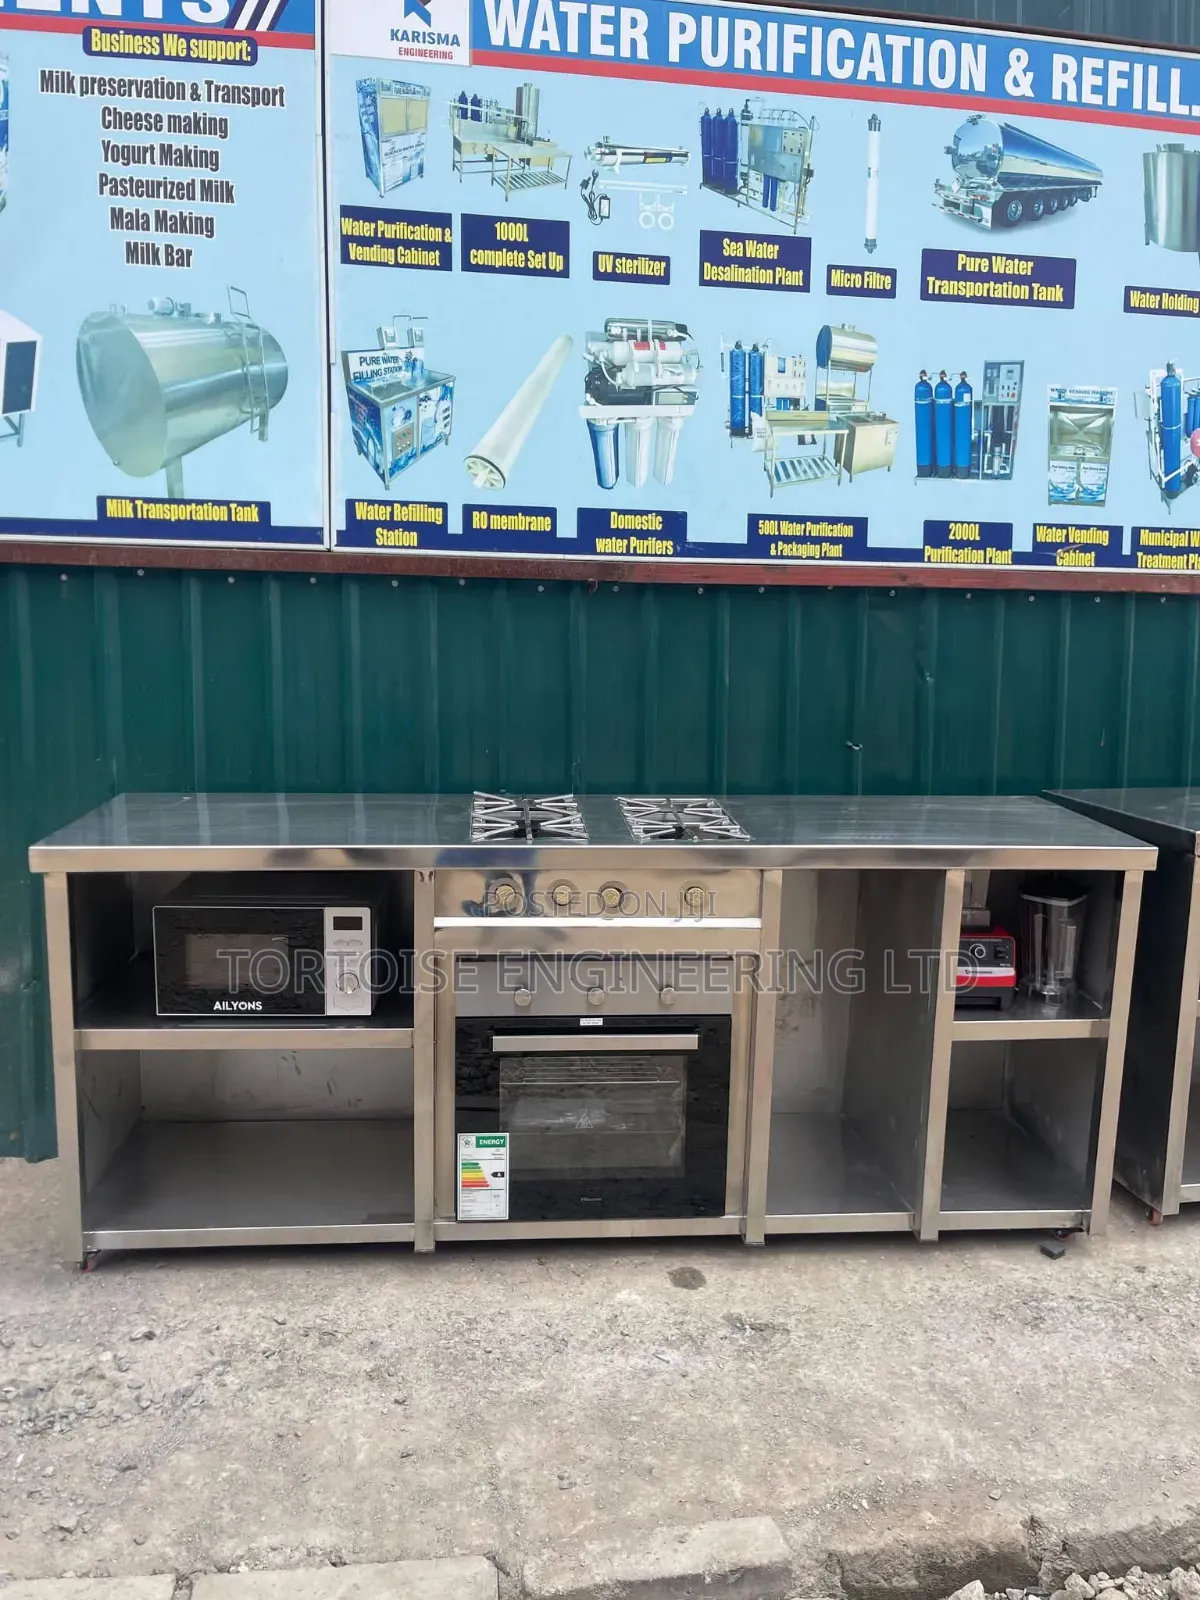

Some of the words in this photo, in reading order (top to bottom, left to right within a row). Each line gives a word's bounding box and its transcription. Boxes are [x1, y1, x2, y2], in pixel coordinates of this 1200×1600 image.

[91, 28, 160, 56] Business
[163, 33, 187, 57] We
[189, 38, 251, 62] support:
[390, 28, 461, 47] KARISMA
[398, 47, 453, 60] ENGINEERING
[484, 0, 649, 60] WATER
[669, 12, 986, 92] PURIFICATION
[1004, 47, 1035, 98] &
[40, 70, 75, 94] Milk
[80, 75, 185, 100] preservation
[190, 82, 201, 101] &
[205, 80, 285, 107] Transport
[101, 107, 163, 132] Cheese
[167, 113, 228, 139] making
[101, 140, 155, 166] Yogurt
[159, 143, 219, 171] Making
[99, 173, 195, 201] Pasteurized
[200, 179, 235, 203] Milk
[110, 207, 150, 232] Mala
[155, 210, 214, 237] Making
[341, 217, 375, 238] Water
[377, 220, 442, 242] Purification
[444, 229, 452, 243] &
[494, 222, 529, 243] 1000L
[125, 242, 160, 266] Milk
[165, 244, 192, 267] Bar
[349, 243, 395, 265] Vending
[397, 245, 440, 266] Cabinet
[723, 238, 742, 257] Sea
[745, 240, 779, 259] Water
[470, 249, 525, 270] complete
[527, 251, 546, 270] Set
[548, 252, 564, 272] Up
[598, 254, 613, 272] UV
[615, 258, 666, 277] sterilizer
[957, 253, 990, 274] Pure
[992, 256, 1034, 276] Water
[704, 262, 772, 286] Desalination
[775, 268, 804, 287] Plant
[831, 270, 861, 288] Micro
[864, 271, 892, 290] Filtre
[927, 277, 1028, 301] Transportation
[1032, 282, 1064, 303] Tank
[1130, 290, 1160, 309] Water
[1162, 292, 1199, 313] Holding
[359, 356, 381, 366] PURE
[106, 498, 133, 518] Milk
[135, 500, 228, 522] Transportation
[230, 503, 259, 522] Tank
[355, 501, 391, 521] Water
[393, 503, 443, 524] Refilling
[610, 511, 662, 530] Domestic
[472, 511, 487, 529] RO
[490, 513, 551, 531] membrane
[758, 520, 779, 535] 500L
[780, 521, 805, 536] Water
[806, 522, 853, 537] Purification
[376, 527, 417, 547] Station
[949, 523, 980, 541] 2000L
[1036, 525, 1066, 543] Water
[1068, 527, 1109, 546] Vending
[1140, 529, 1189, 548] Municipal
[596, 537, 628, 553] water
[770, 543, 776, 556] &
[778, 541, 820, 558] Packaging
[821, 542, 843, 557] Plant
[924, 545, 984, 564] Purification
[986, 548, 1013, 565] Plant
[1056, 548, 1095, 567] Cabinet
[1137, 552, 1187, 569] Treatment
[213, 1000, 262, 1011] AILYONS
